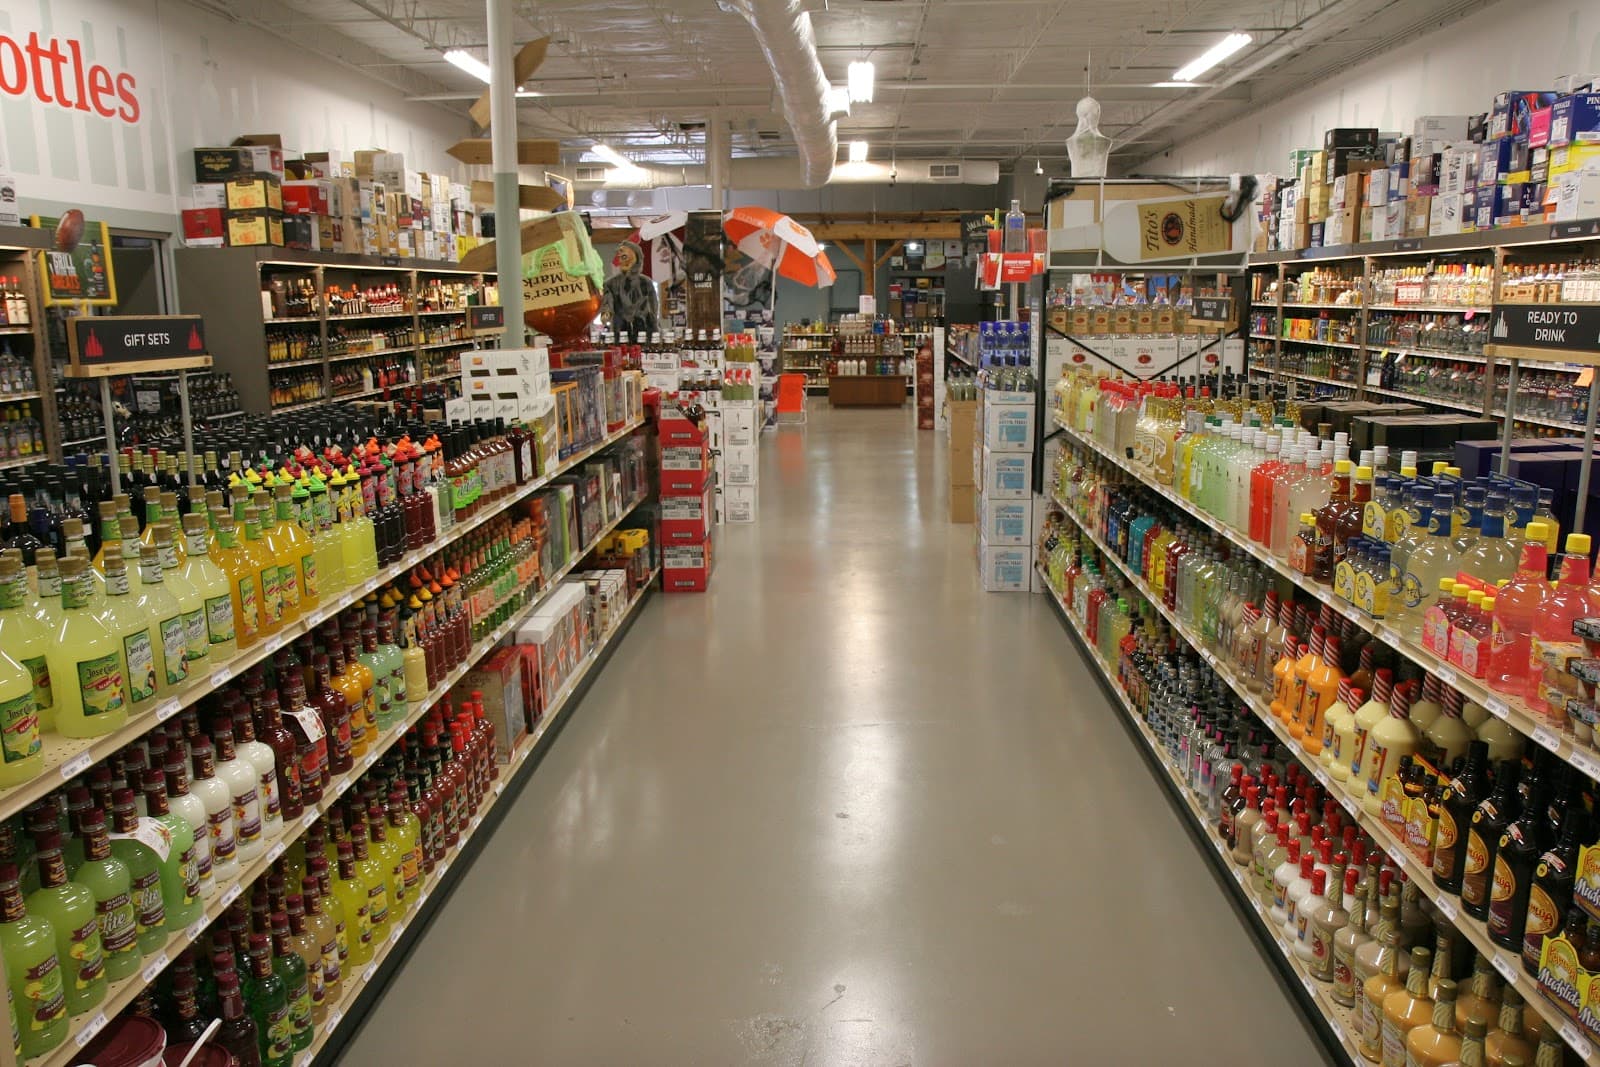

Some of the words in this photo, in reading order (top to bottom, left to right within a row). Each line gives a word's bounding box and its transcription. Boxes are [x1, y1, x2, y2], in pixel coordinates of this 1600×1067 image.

[0, 31, 140, 124] ottles
[1144, 209, 1160, 252] Tito's
[1184, 200, 1198, 253] Handmade
[522, 272, 564, 288] Mark
[524, 282, 584, 300] Maker's
[1528, 311, 1561, 324] READY
[1563, 312, 1578, 325] TO
[124, 334, 146, 347] GIFT
[147, 333, 170, 345] SETS
[1535, 328, 1566, 342] DRINK
[86, 667, 103, 679] Jose
[6, 707, 25, 722] Jose
[1537, 966, 1581, 1008] Mudslide
